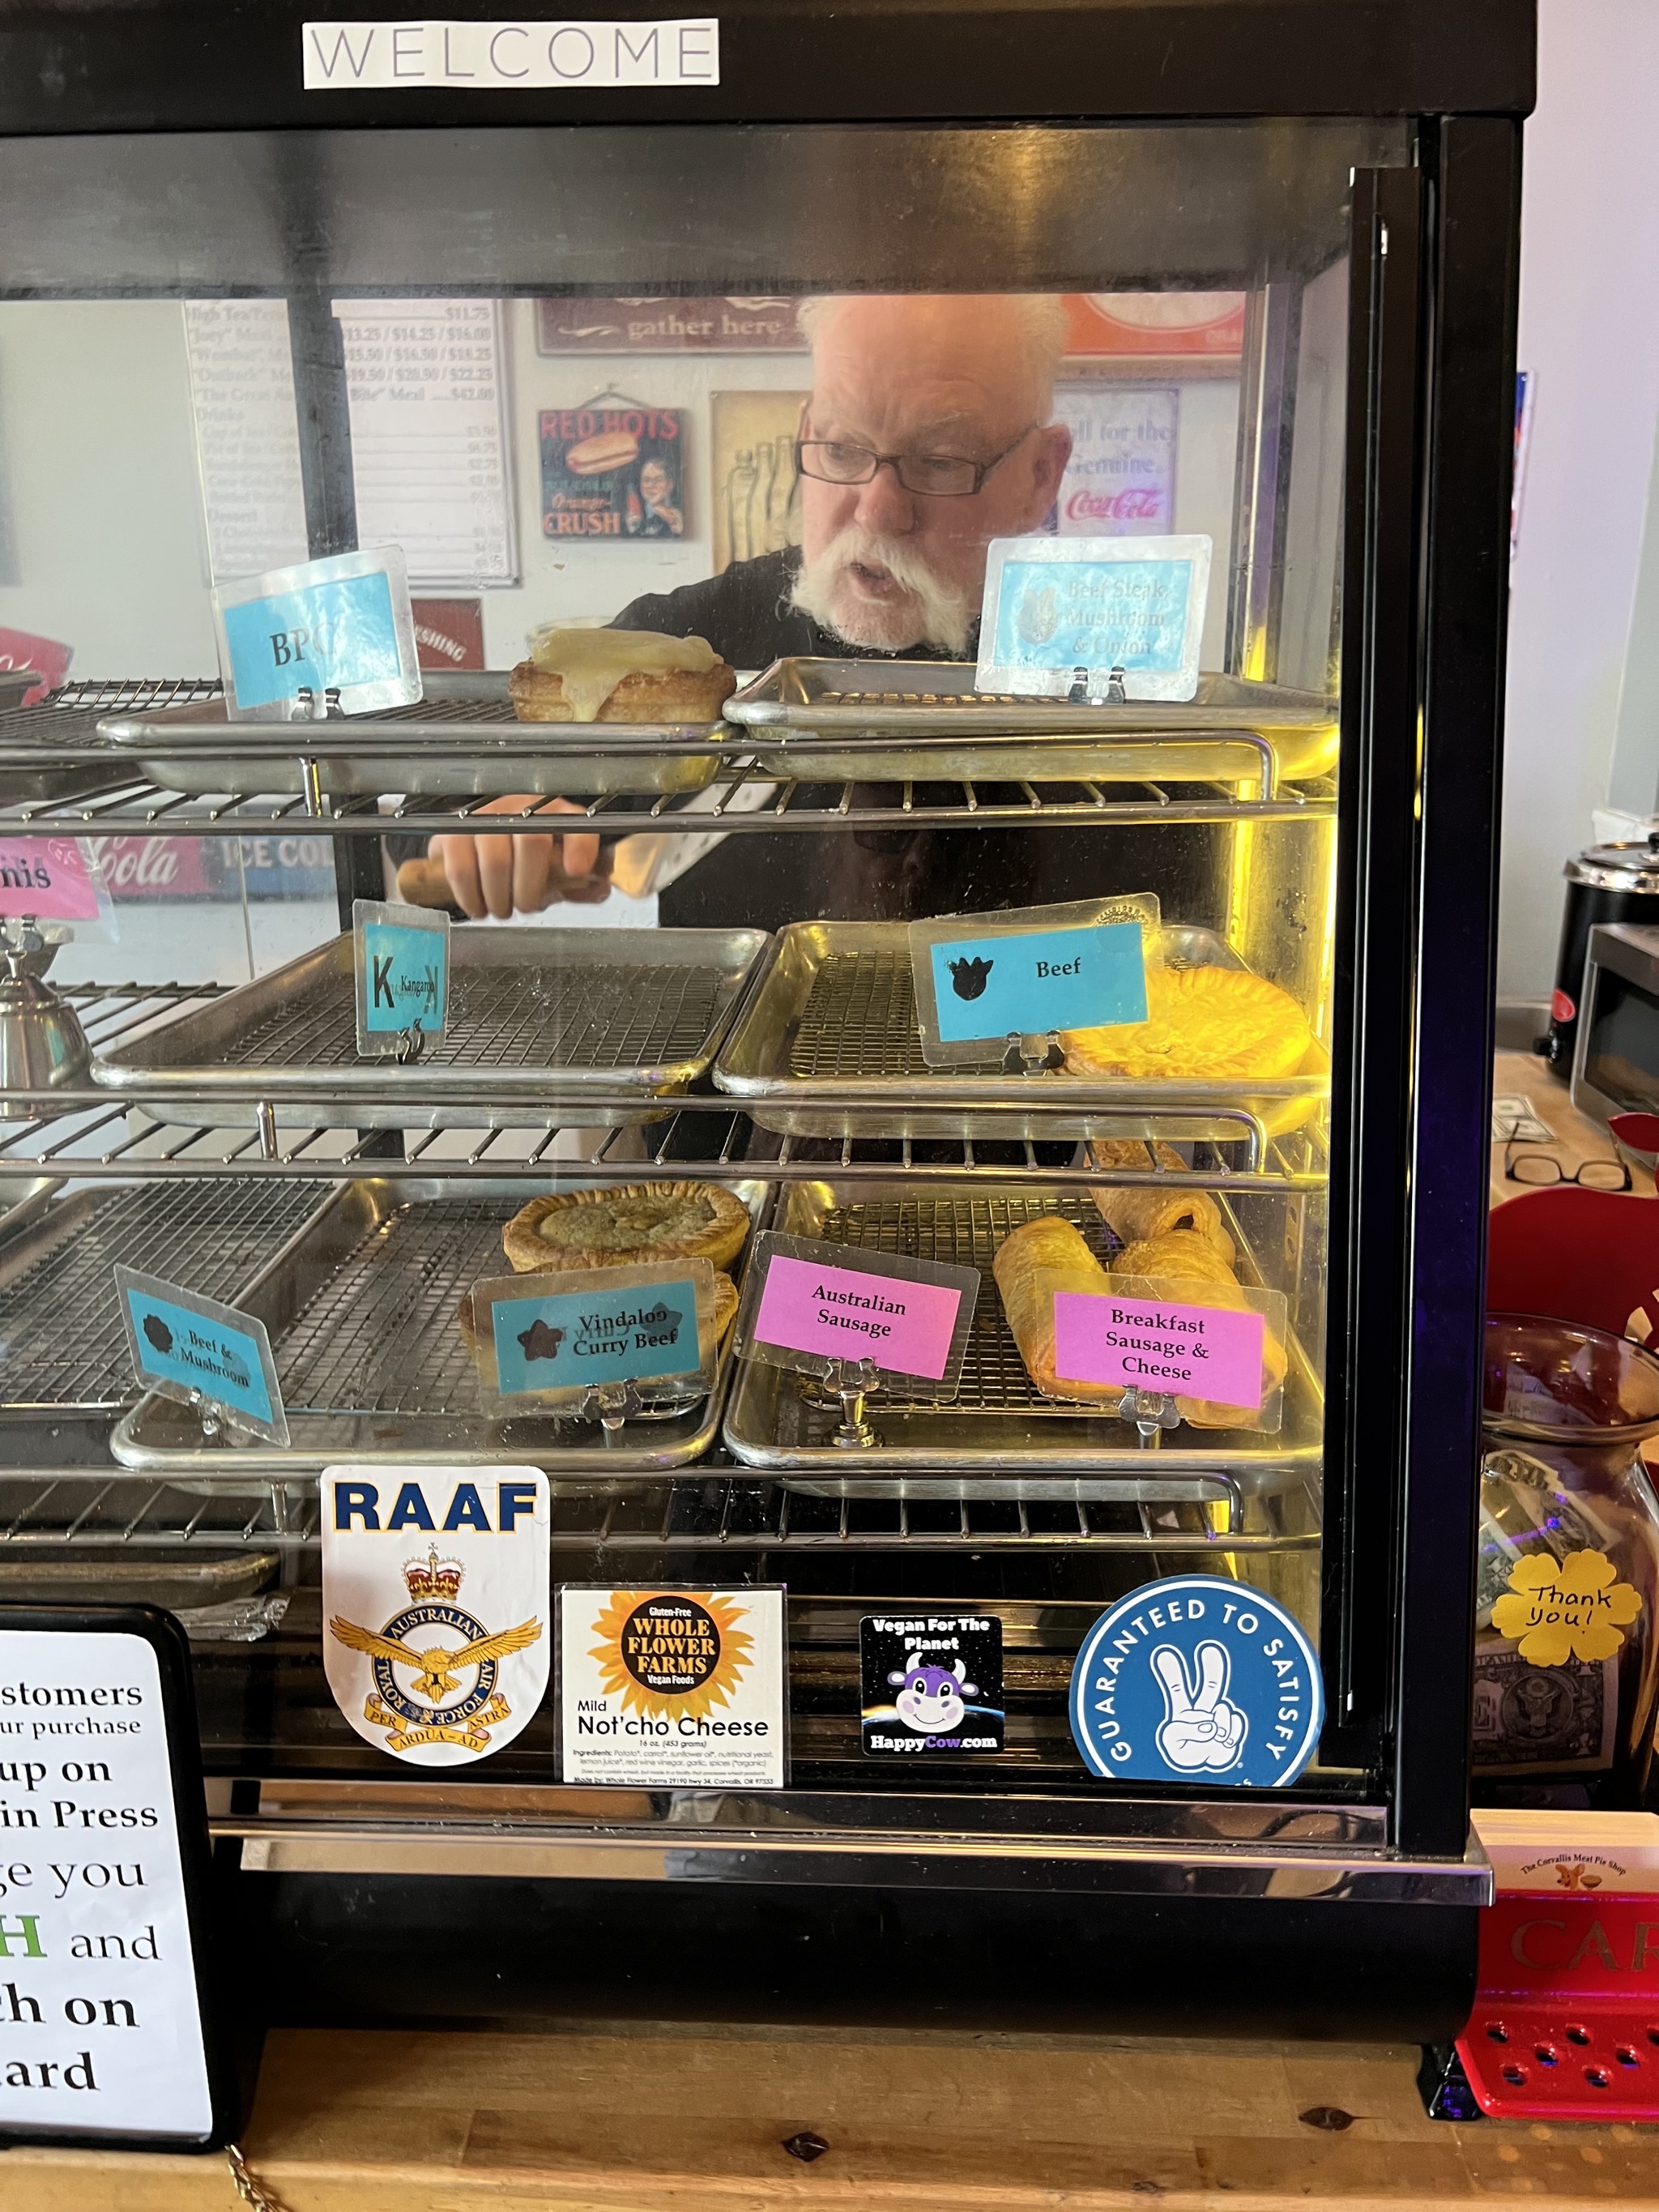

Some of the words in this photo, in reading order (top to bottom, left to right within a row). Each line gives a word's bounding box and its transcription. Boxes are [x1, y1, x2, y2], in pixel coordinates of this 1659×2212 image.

[311, 28, 712, 79] WELCOME
[628, 314, 714, 340] gather
[721, 314, 782, 335] here
[540, 411, 595, 440] RED
[603, 410, 680, 440] HOTS
[542, 511, 621, 536] CRUSH
[1068, 580, 1107, 600] Beef
[1066, 609, 1165, 629] Mushroom
[1071, 635, 1088, 655] &
[1094, 636, 1152, 655] Onion
[222, 840, 273, 868] ICE
[278, 839, 335, 868] COL
[0, 858, 51, 890] nis
[1036, 957, 1082, 979] Beef
[373, 954, 395, 1009] K
[400, 975, 435, 998] Kangaroo
[811, 1284, 906, 1316] Australian
[578, 1309, 667, 1331] Vindaloo
[817, 1309, 892, 1339] Sausage
[1111, 1308, 1205, 1334] Breakfast
[189, 1329, 218, 1354] Beef
[220, 1343, 232, 1360] &
[573, 1339, 629, 1356] Curry
[633, 1328, 677, 1349] Beef
[1106, 1331, 1186, 1359] Sausage
[1192, 1343, 1210, 1360] &
[180, 1346, 250, 1388] Mushroom
[1121, 1356, 1192, 1381] Cheese
[333, 1480, 539, 1533] RAAF
[1528, 1584, 1613, 1608] Thank
[391, 1607, 482, 1641] AUSTRALIAN
[649, 1607, 692, 1617] Gluten-Free
[633, 1618, 710, 1636] WHOLE
[872, 1619, 926, 1635] Vegan
[928, 1618, 956, 1631] For
[957, 1618, 991, 1631] The
[628, 1637, 716, 1655] FLOWER
[904, 1637, 960, 1650] Planet
[480, 1660, 492, 1690] AIR
[637, 1656, 707, 1674] FARMS
[377, 1656, 408, 1708] ROYAL
[647, 1675, 671, 1686] Vegan
[672, 1675, 694, 1685] Foods
[1094, 1599, 1205, 1761] GUARANTEED
[1222, 1603, 1259, 1635] TO
[1263, 1638, 1300, 1760] SATISFY
[0, 1681, 143, 1706] stomers
[577, 1700, 607, 1711] Mild
[369, 1710, 397, 1727] PER
[436, 1690, 483, 1724] FORCE
[468, 1706, 510, 1730] ASTRA
[0, 1721, 24, 1735] ur
[31, 1717, 142, 1740] purchase
[578, 1715, 669, 1735] Not'cho
[678, 1716, 769, 1736] Cheese
[397, 1732, 446, 1749] ARDUA
[458, 1732, 479, 1749] AD
[573, 1749, 612, 1757] Ingredients:
[662, 1740, 679, 1749] (453
[680, 1740, 707, 1749] grams)
[870, 1735, 998, 1752] HappyCow.com
[62, 1761, 113, 1783] on
[49, 1800, 159, 1828] Press
[1520, 1864, 1536, 1875] The
[1537, 1854, 1572, 1867] Corvallis
[1573, 1854, 1593, 1864] Meat
[1594, 1855, 1606, 1865] Pie
[1608, 1860, 1627, 1877] Shop
[46, 1863, 149, 1898] you
[0, 1914, 48, 1958] H
[70, 1925, 164, 1961] and
[63, 1996, 141, 2028] on
[0, 2051, 101, 2091] ard
